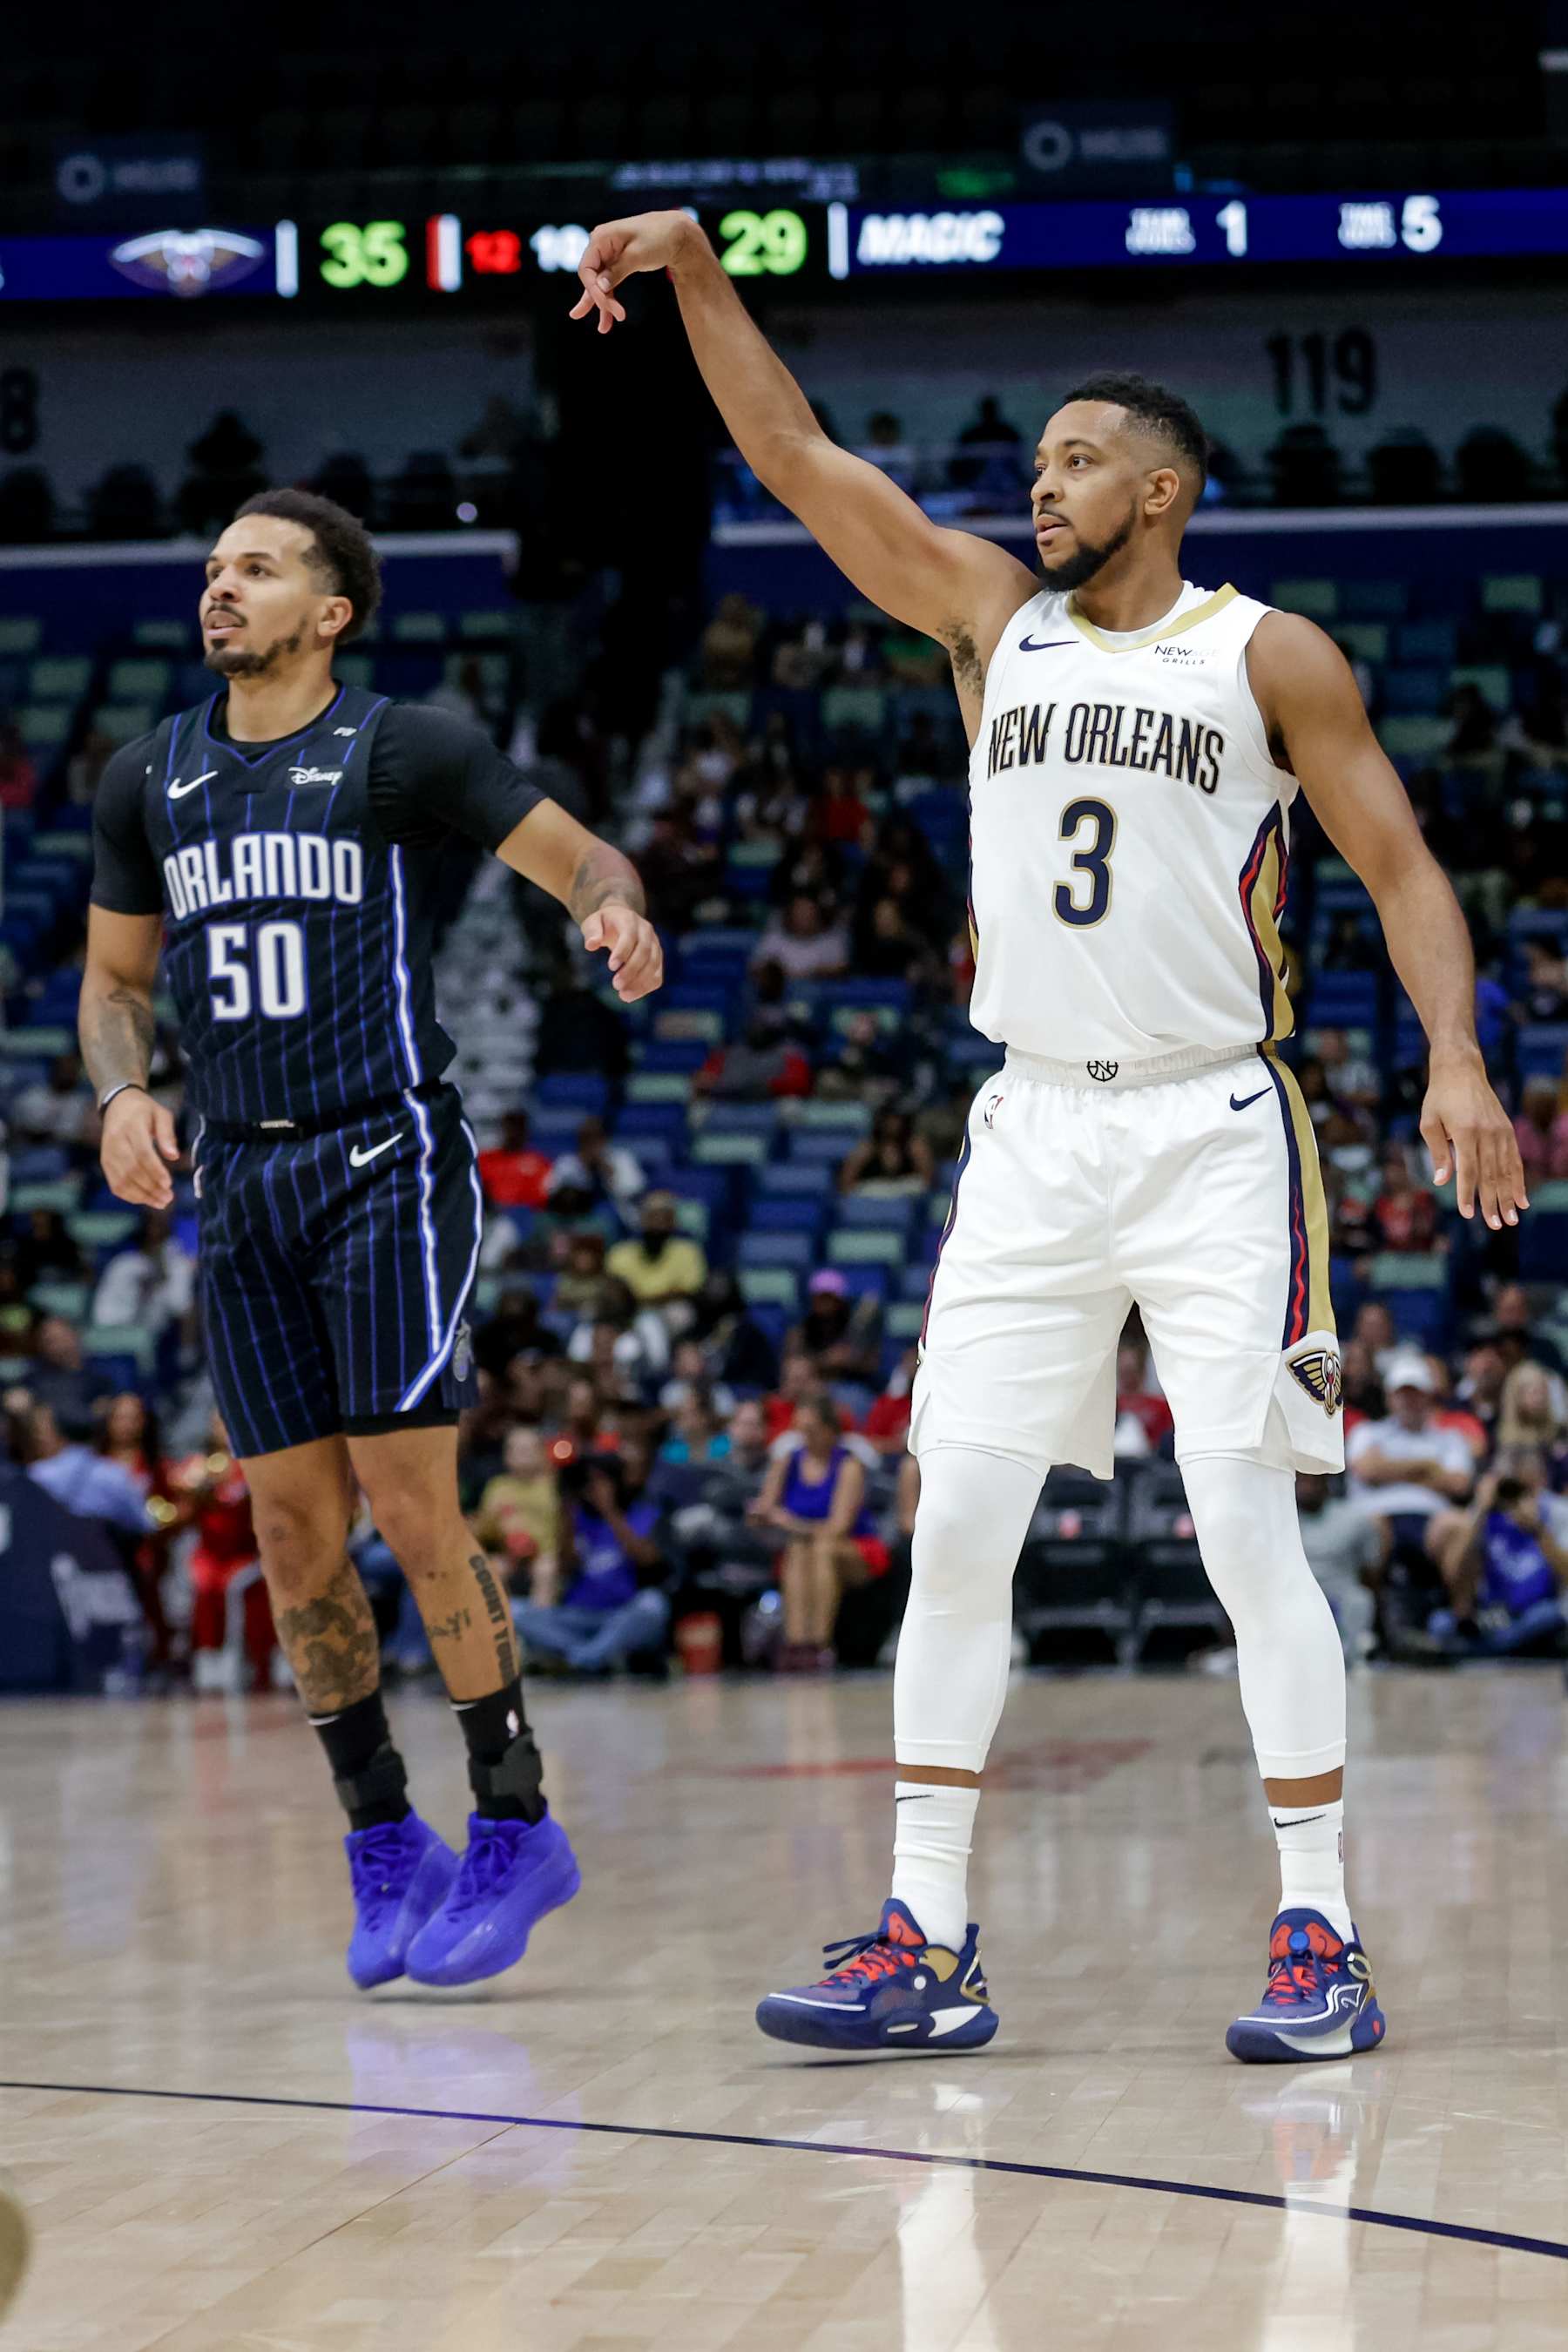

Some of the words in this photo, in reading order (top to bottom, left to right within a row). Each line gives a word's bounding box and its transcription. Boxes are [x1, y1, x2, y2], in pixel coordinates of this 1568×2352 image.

[321, 221, 408, 287] 35
[719, 209, 807, 275] 29
[856, 210, 1005, 265] MAGIC
[1216, 200, 1247, 257] 1
[1402, 195, 1443, 253] 5
[1267, 329, 1375, 416] 119
[987, 703, 1058, 781] NEW
[1064, 702, 1226, 796] ORLEANS
[163, 832, 363, 922] ORLANDO
[1051, 795, 1119, 930] 3
[206, 920, 308, 1022] 50
